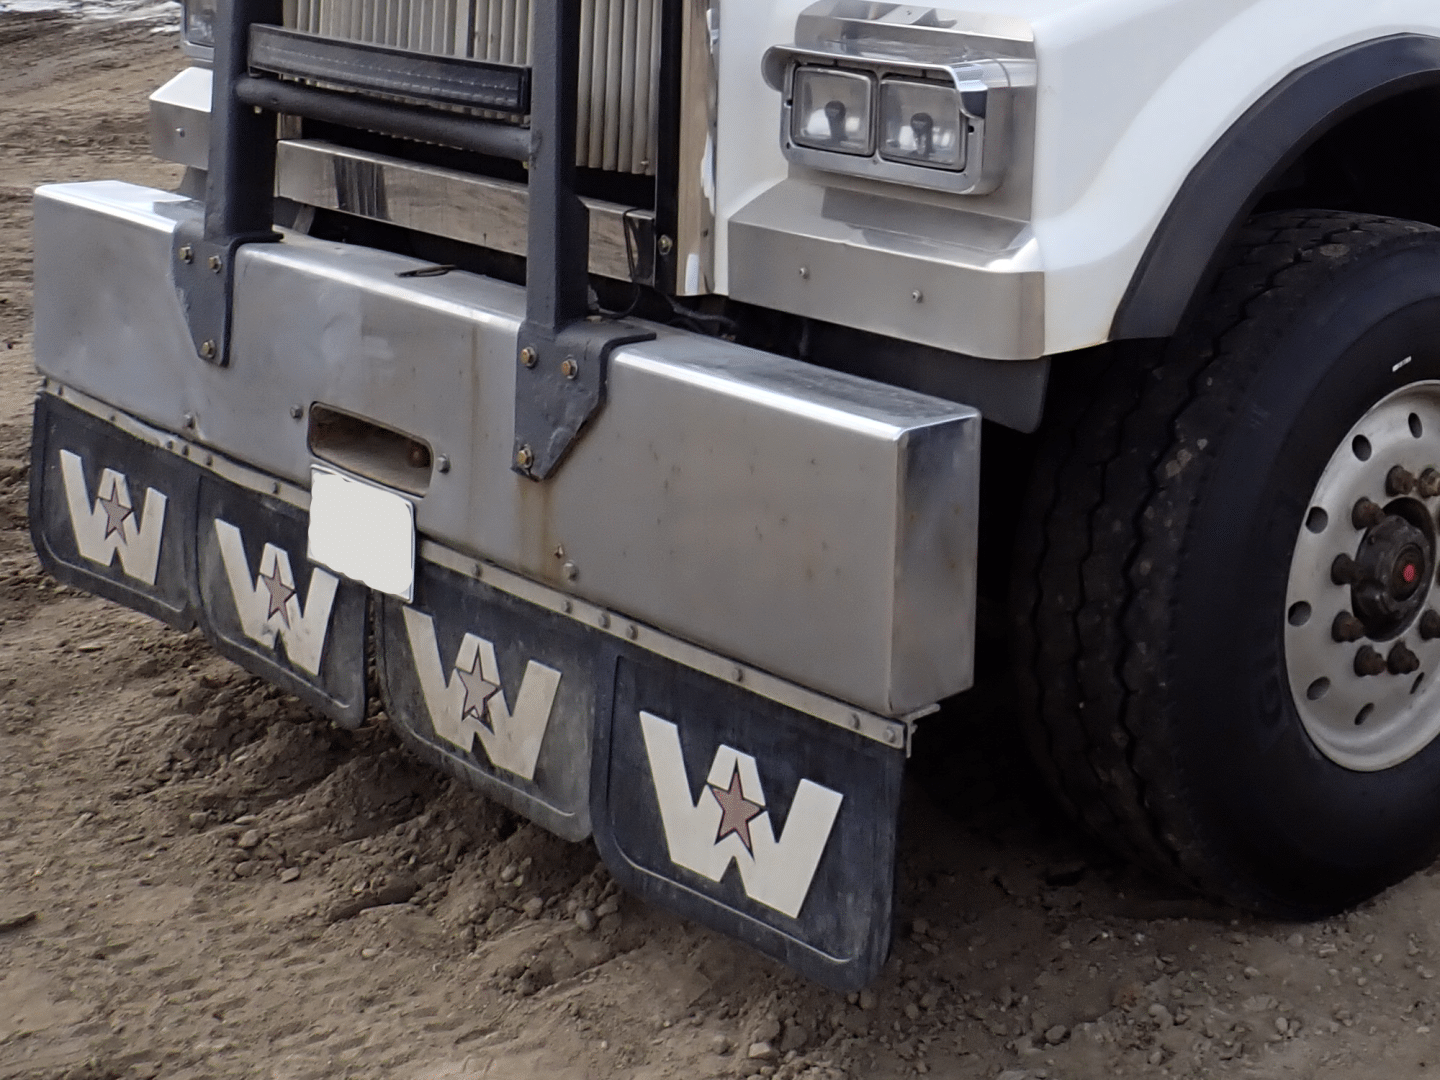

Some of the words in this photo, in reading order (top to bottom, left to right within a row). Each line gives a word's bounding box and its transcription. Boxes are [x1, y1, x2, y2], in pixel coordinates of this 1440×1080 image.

[60, 449, 168, 585] W
[215, 518, 339, 676] W
[402, 606, 562, 780] W
[639, 710, 844, 918] W
